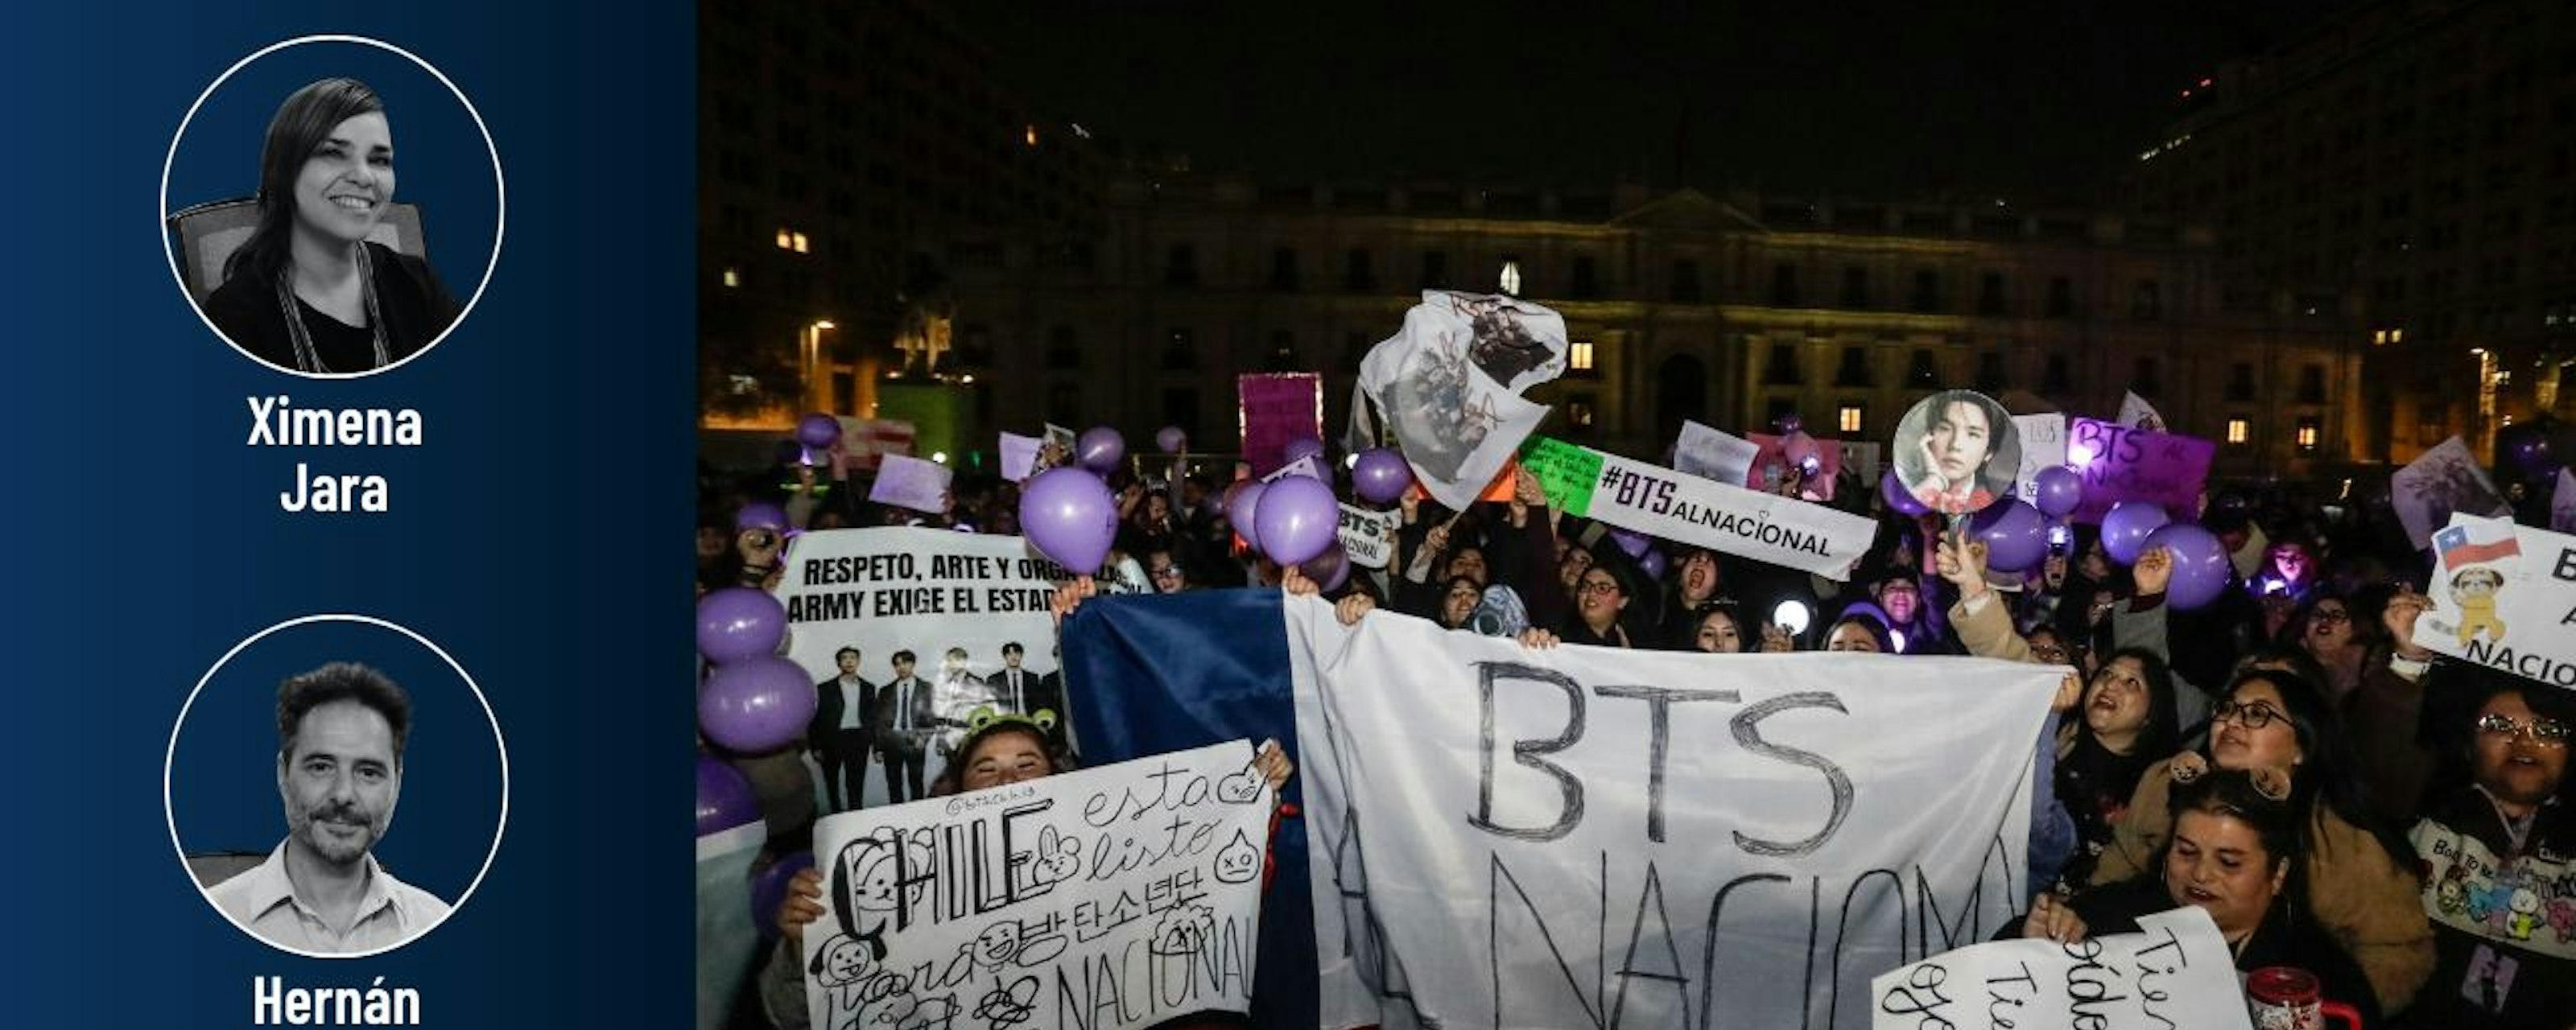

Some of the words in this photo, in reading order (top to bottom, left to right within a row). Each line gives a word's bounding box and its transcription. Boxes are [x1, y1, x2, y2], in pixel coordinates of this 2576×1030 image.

[2077, 420, 2142, 464] BTS
[805, 552, 923, 586] RESPETO,
[931, 555, 991, 579] ARTE
[996, 556, 1009, 579] Y
[788, 591, 865, 624] ARMY
[875, 589, 944, 616] EXIGE
[954, 589, 980, 613] EL
[988, 588, 1055, 612] ESTAD
[1467, 661, 1855, 856] BTS
[1084, 762, 1210, 828] esta
[1085, 813, 1222, 881] listo
